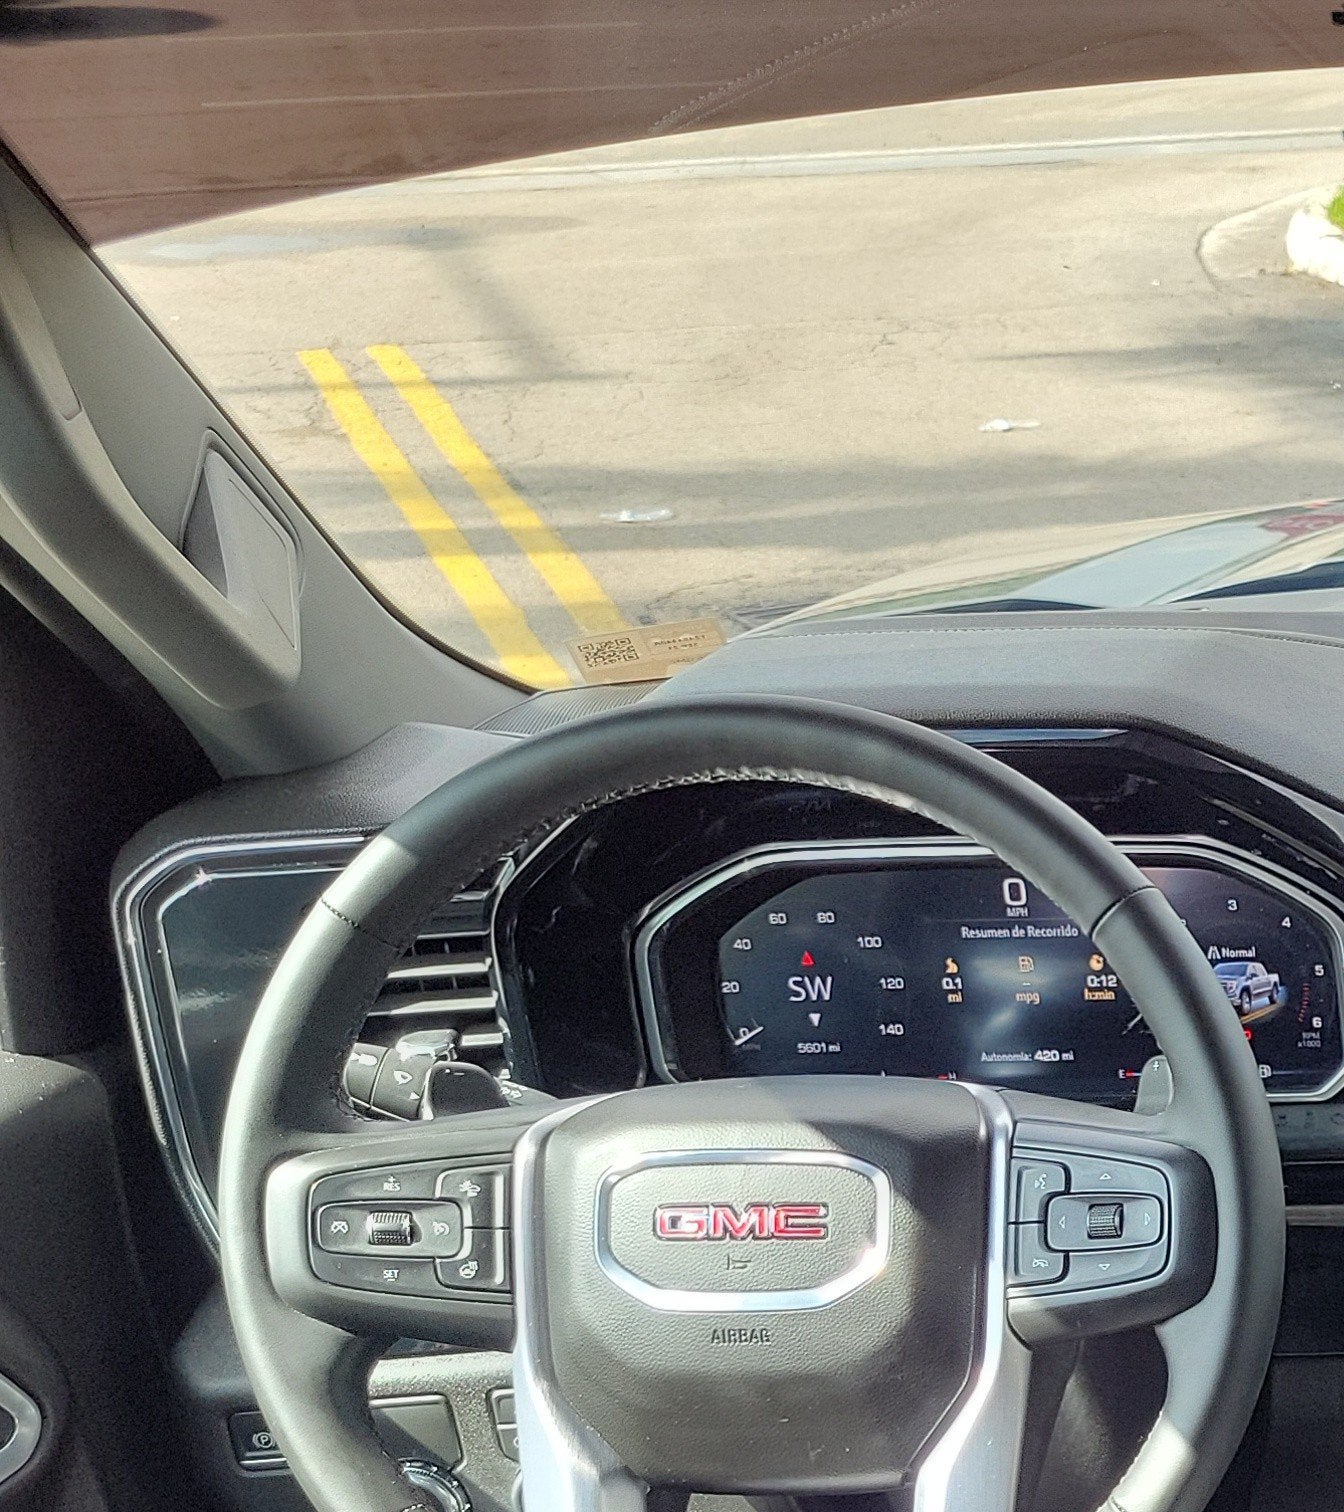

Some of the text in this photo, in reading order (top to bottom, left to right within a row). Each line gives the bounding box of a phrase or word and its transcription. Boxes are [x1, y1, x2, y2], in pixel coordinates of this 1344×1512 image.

[1002, 877, 1028, 906] 0
[1227, 899, 1238, 911] 3
[768, 912, 788, 925] 60
[816, 911, 835, 924] 80
[1006, 907, 1029, 917] MPH
[1281, 916, 1292, 928] 4
[961, 924, 1079, 938] Resumen de Recorrido
[733, 938, 752, 950] 40
[856, 936, 882, 948] 100
[1221, 945, 1256, 958] Normal
[1314, 964, 1325, 976] 5
[721, 981, 740, 994] 20
[786, 975, 834, 1002] SW
[879, 977, 905, 990] 120
[1015, 992, 1040, 1005] mpg
[1312, 1016, 1323, 1028] 6
[879, 1023, 904, 1036] 140
[828, 1042, 842, 1053] mi
[1034, 1049, 1060, 1062] 420
[1061, 1050, 1075, 1061] mi
[382, 1182, 401, 1192] RES
[652, 1202, 830, 1242] GMC
[382, 1269, 400, 1280] SET
[710, 1328, 772, 1345] AIRBAG
